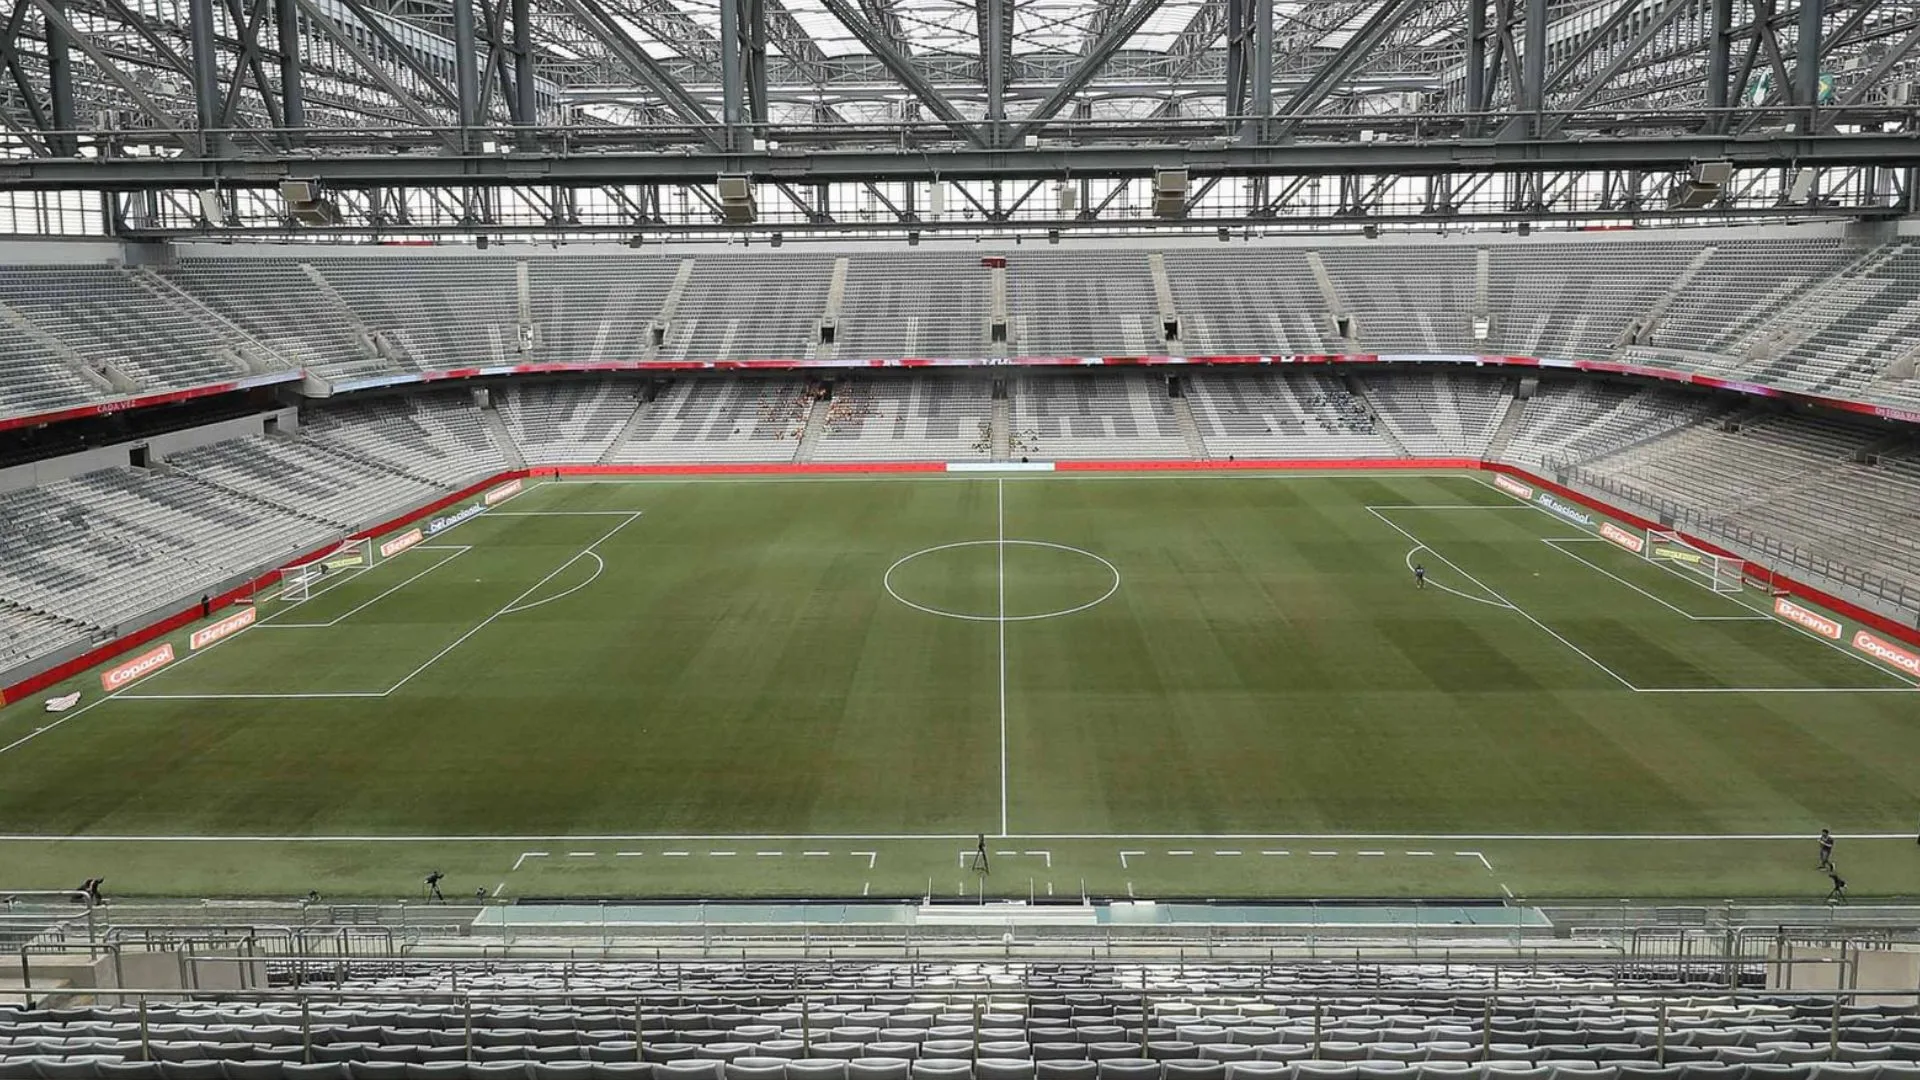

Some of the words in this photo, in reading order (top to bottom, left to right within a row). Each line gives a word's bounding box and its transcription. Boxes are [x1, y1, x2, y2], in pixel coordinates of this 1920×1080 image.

[199, 613, 251, 646] Betano
[1779, 600, 1833, 634] Betano
[110, 647, 168, 683] Copacol
[1858, 635, 1920, 673] Copacol
